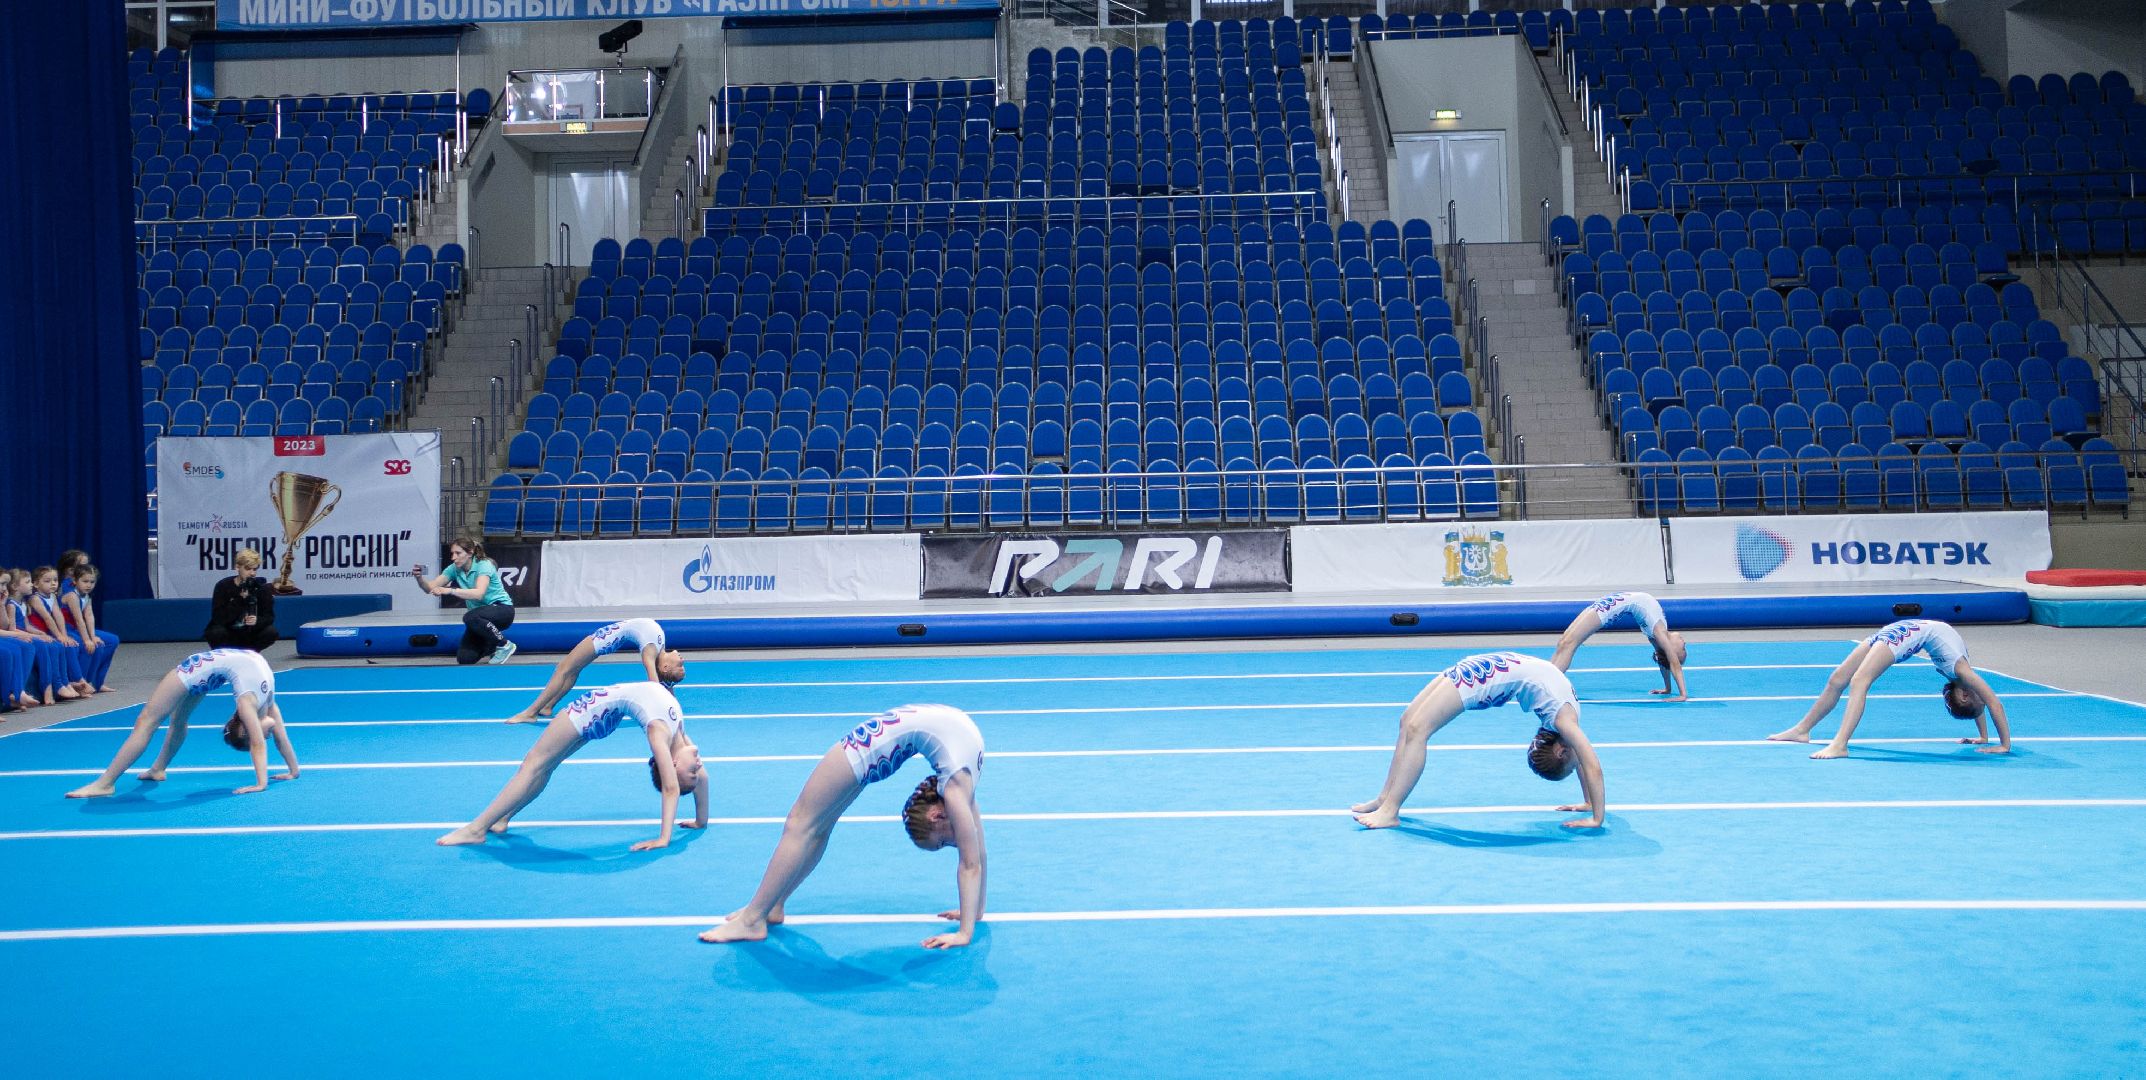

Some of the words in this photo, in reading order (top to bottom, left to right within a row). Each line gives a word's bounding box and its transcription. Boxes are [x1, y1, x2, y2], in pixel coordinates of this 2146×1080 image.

[283, 440, 316, 451] 2023
[184, 465, 222, 475] SMDES
[178, 521, 210, 530] TEAMGYM
[222, 520, 249, 529] RUSSIA
[1811, 541, 1992, 566] НОВАТЭК
[988, 535, 1223, 594] PARI
[319, 570, 367, 580] КОМАНДНОЙ
[369, 570, 415, 579] ГИМНАСТИ
[497, 565, 528, 587] RI
[713, 575, 776, 591] ГАЗПРОМ
